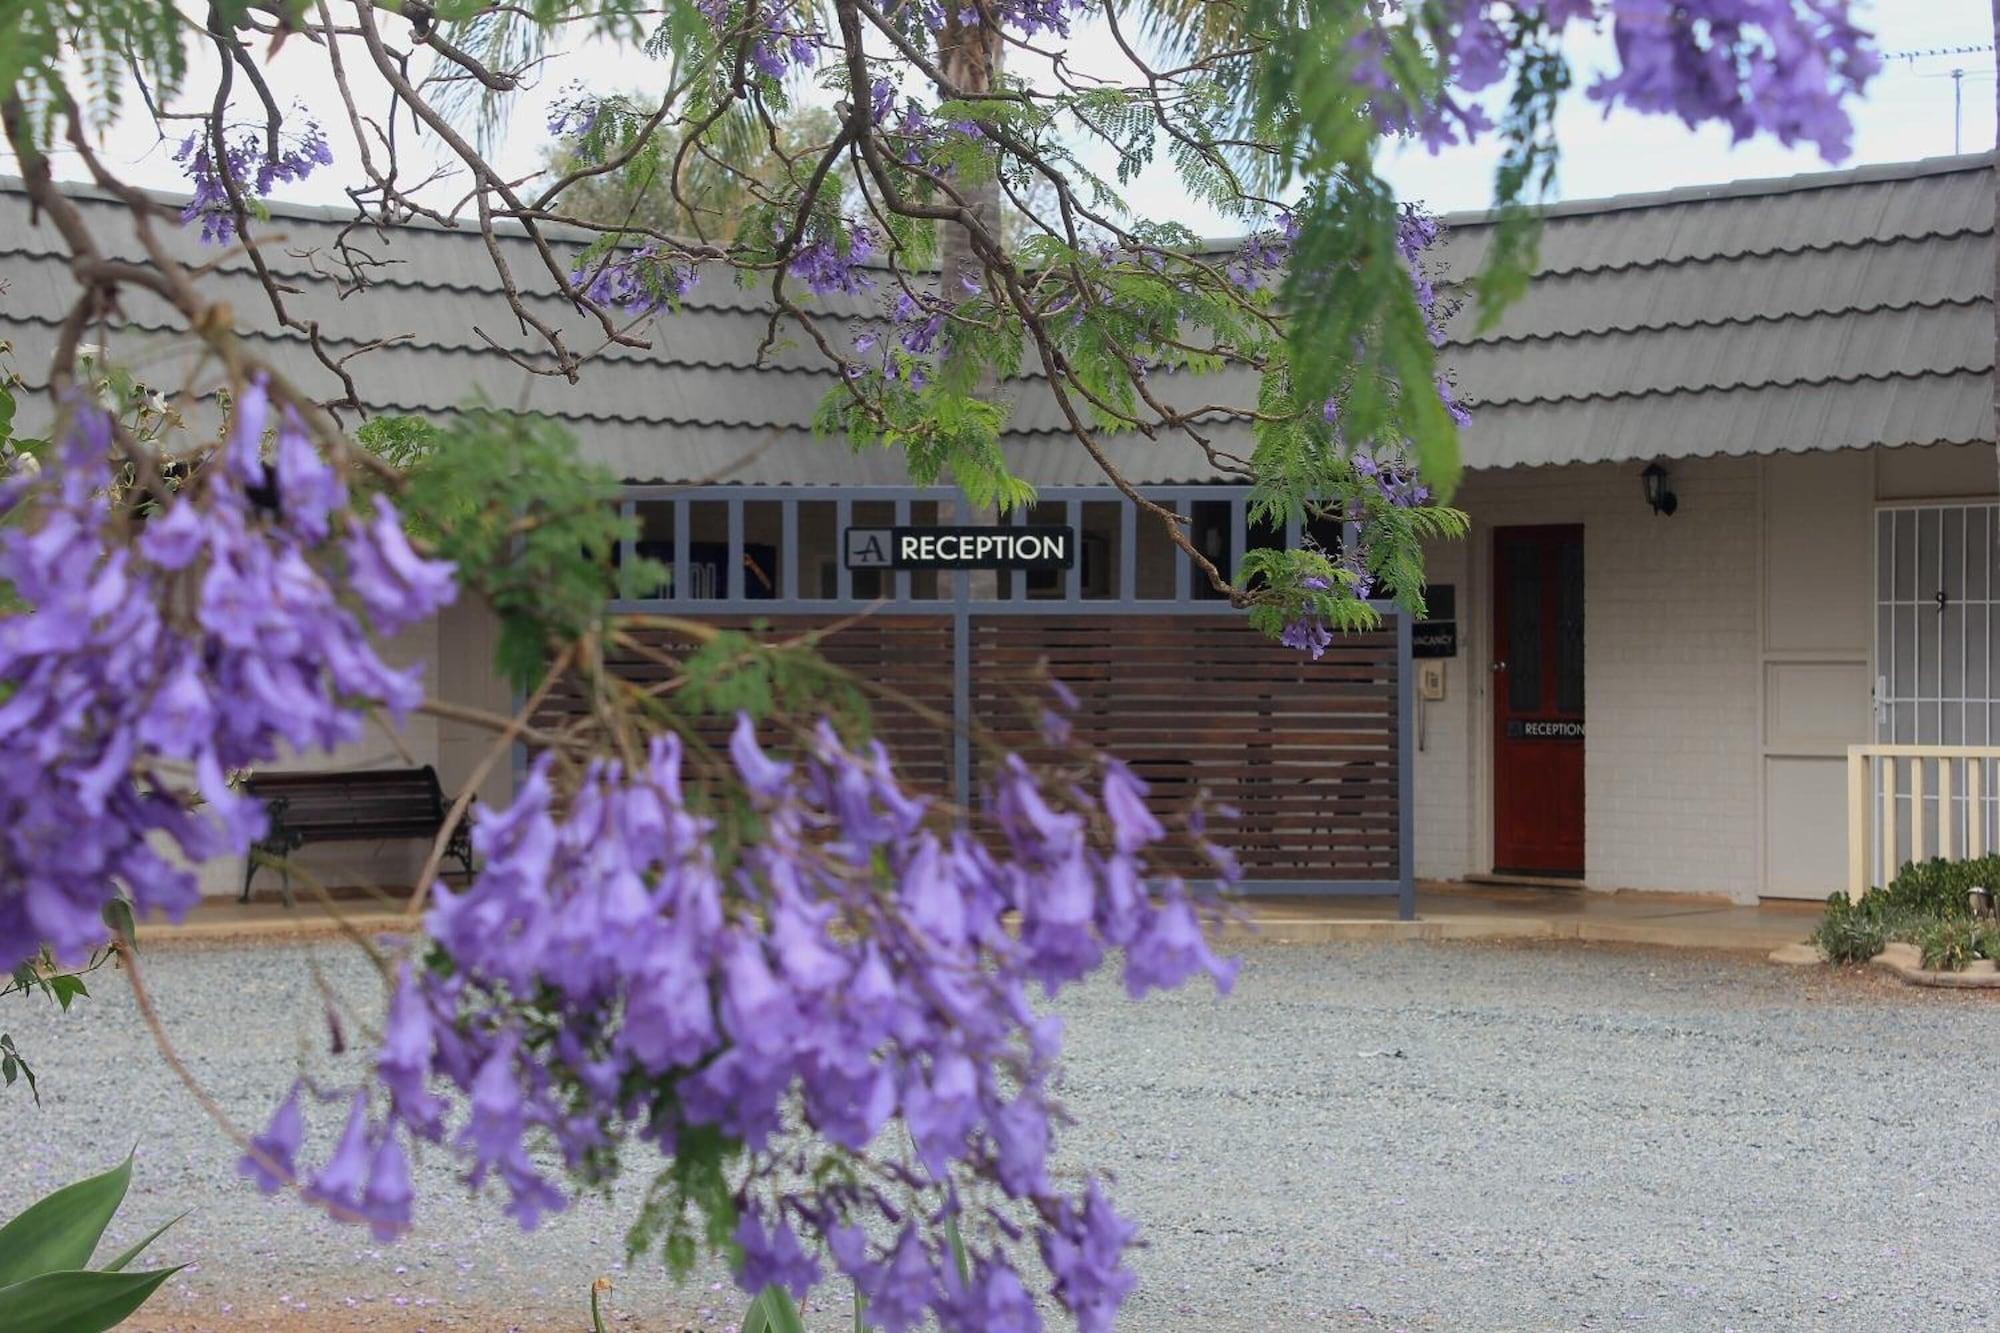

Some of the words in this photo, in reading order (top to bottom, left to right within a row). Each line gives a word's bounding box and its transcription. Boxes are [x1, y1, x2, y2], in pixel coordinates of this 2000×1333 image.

[901, 535, 1064, 561] RECEPTION
[1413, 634, 1453, 647] ACANCY
[1524, 722, 1585, 736] RECEPTION
